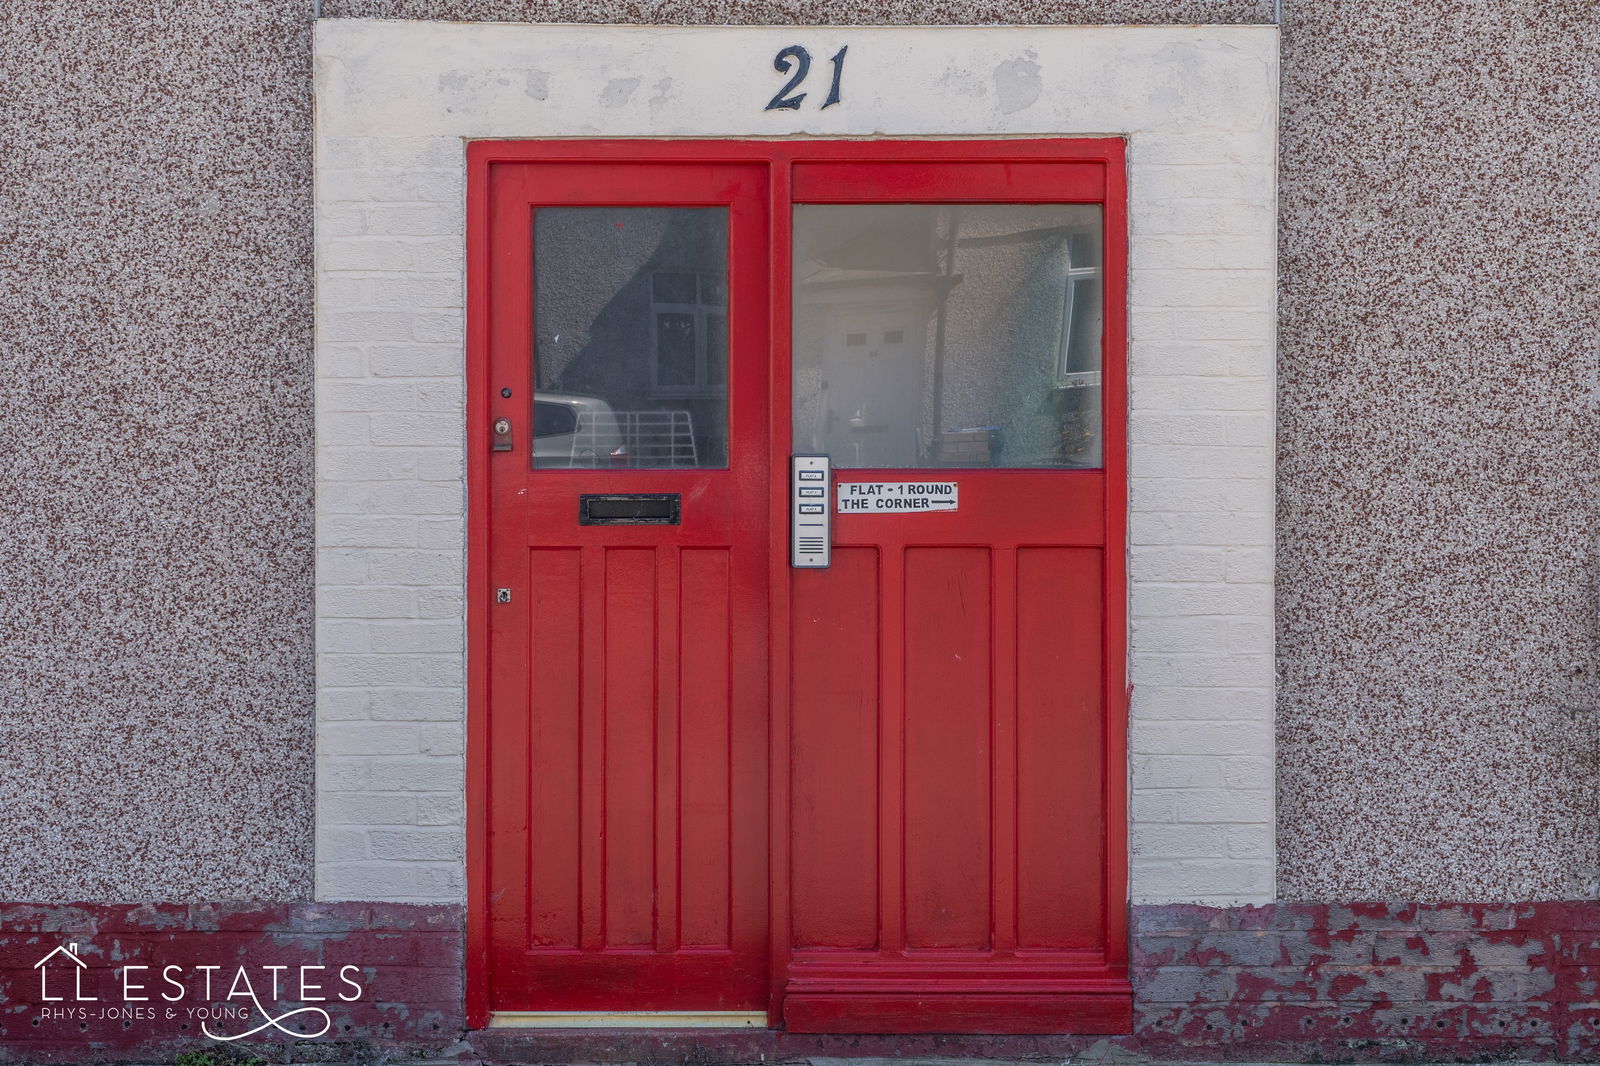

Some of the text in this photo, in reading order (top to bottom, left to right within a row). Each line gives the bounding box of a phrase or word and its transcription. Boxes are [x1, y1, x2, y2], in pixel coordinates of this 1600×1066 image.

[764, 45, 848, 111] 21
[850, 485, 883, 495] FLAT
[897, 485, 904, 495] 1
[908, 484, 952, 495] ROUND
[841, 498, 930, 509] THE CORNER
